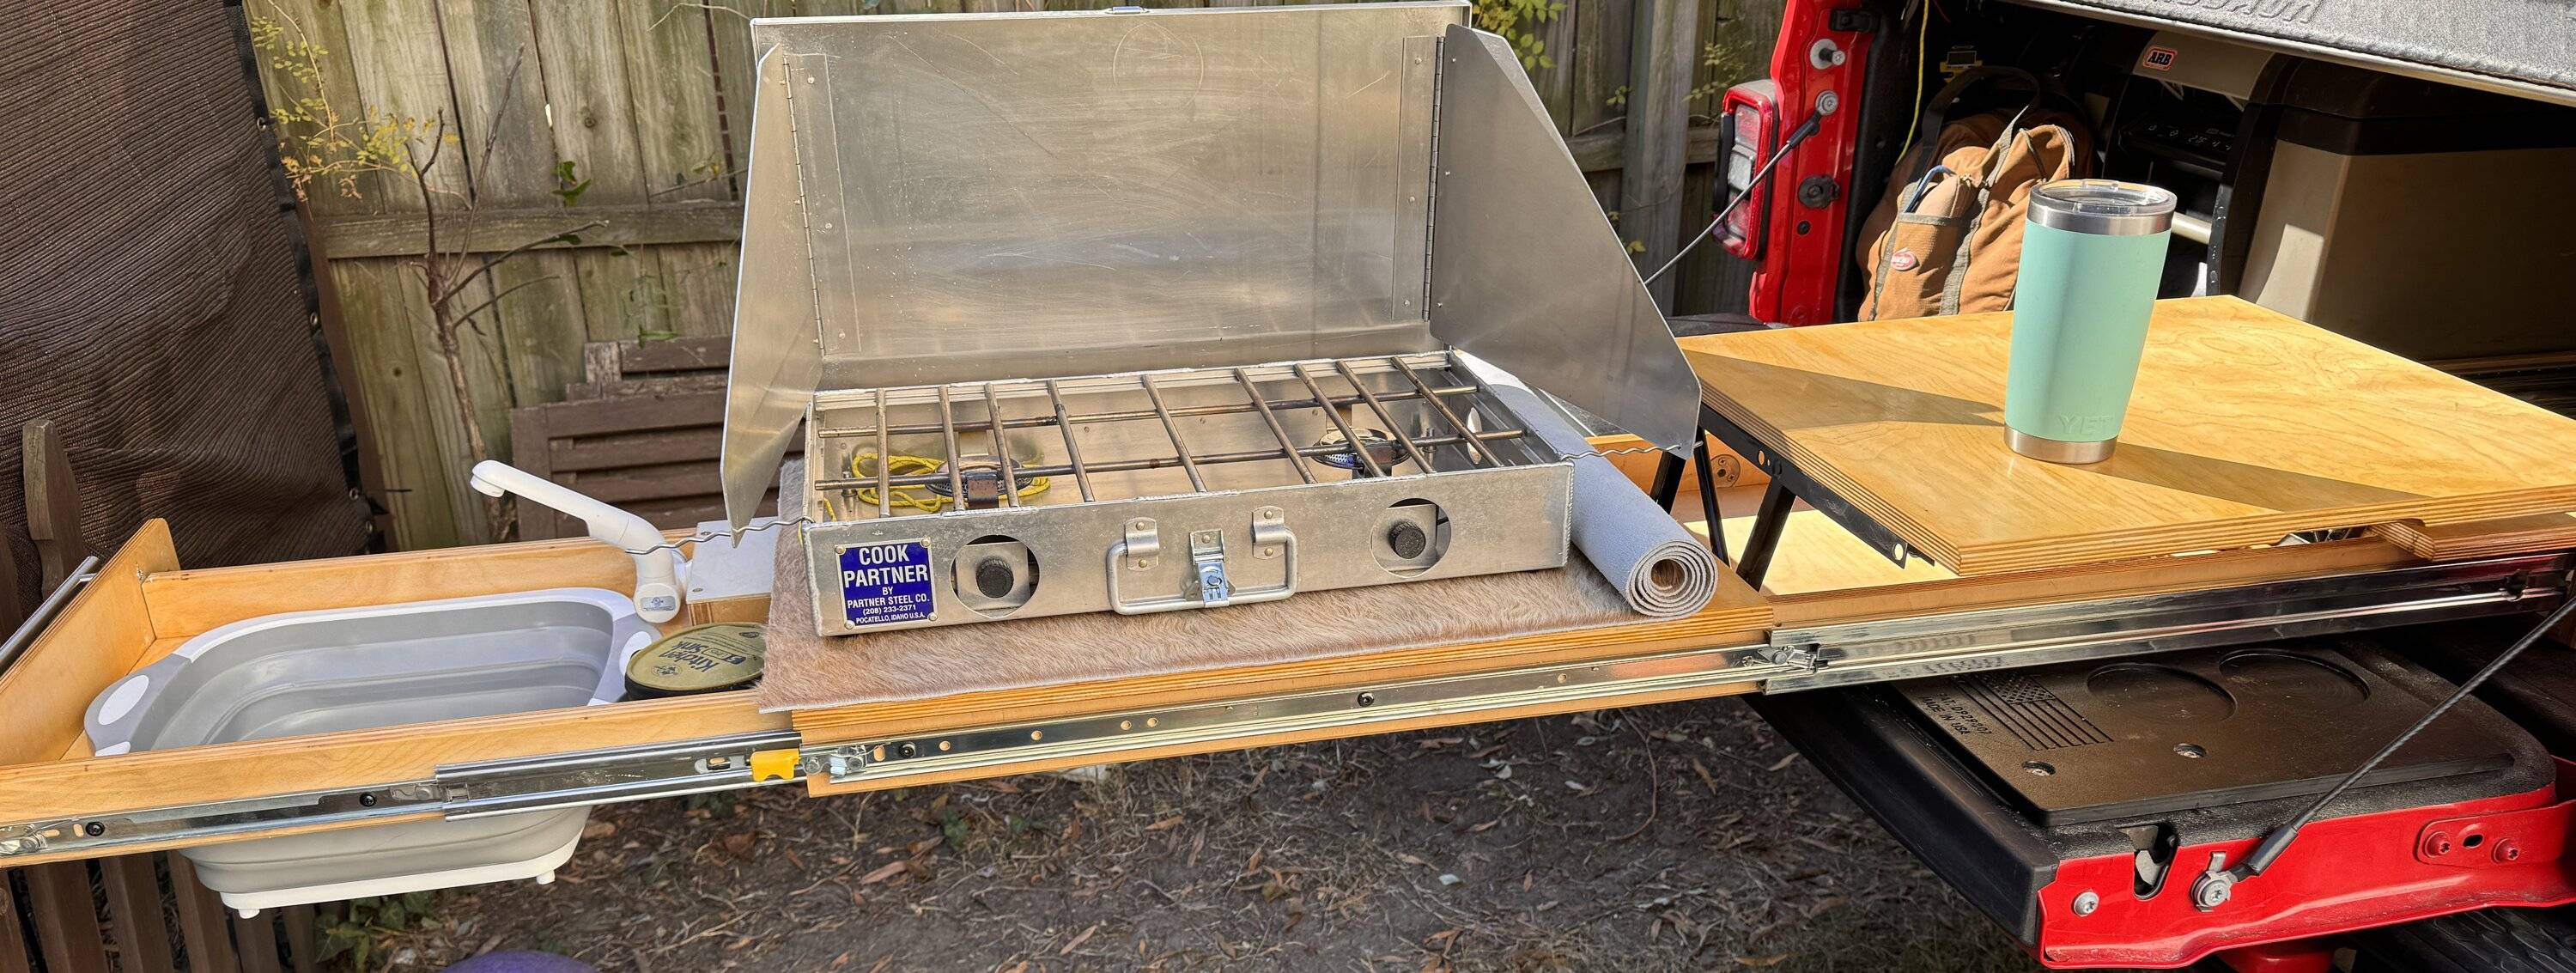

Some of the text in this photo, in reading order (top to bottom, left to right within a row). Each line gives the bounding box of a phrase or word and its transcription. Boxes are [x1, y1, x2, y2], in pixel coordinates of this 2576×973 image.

[2146, 52, 2172, 65] ARB
[859, 544, 909, 566] COOK
[843, 564, 928, 588] PARTNER
[882, 586, 894, 596] BY
[847, 593, 930, 609] PARTNER STEEL CO.
[862, 604, 916, 616] (208) 233-2371
[855, 615, 890, 624] POCATELLO,
[890, 612, 908, 621] IDAHO
[671, 641, 709, 654] Sink
[659, 650, 720, 672] Kitchen
